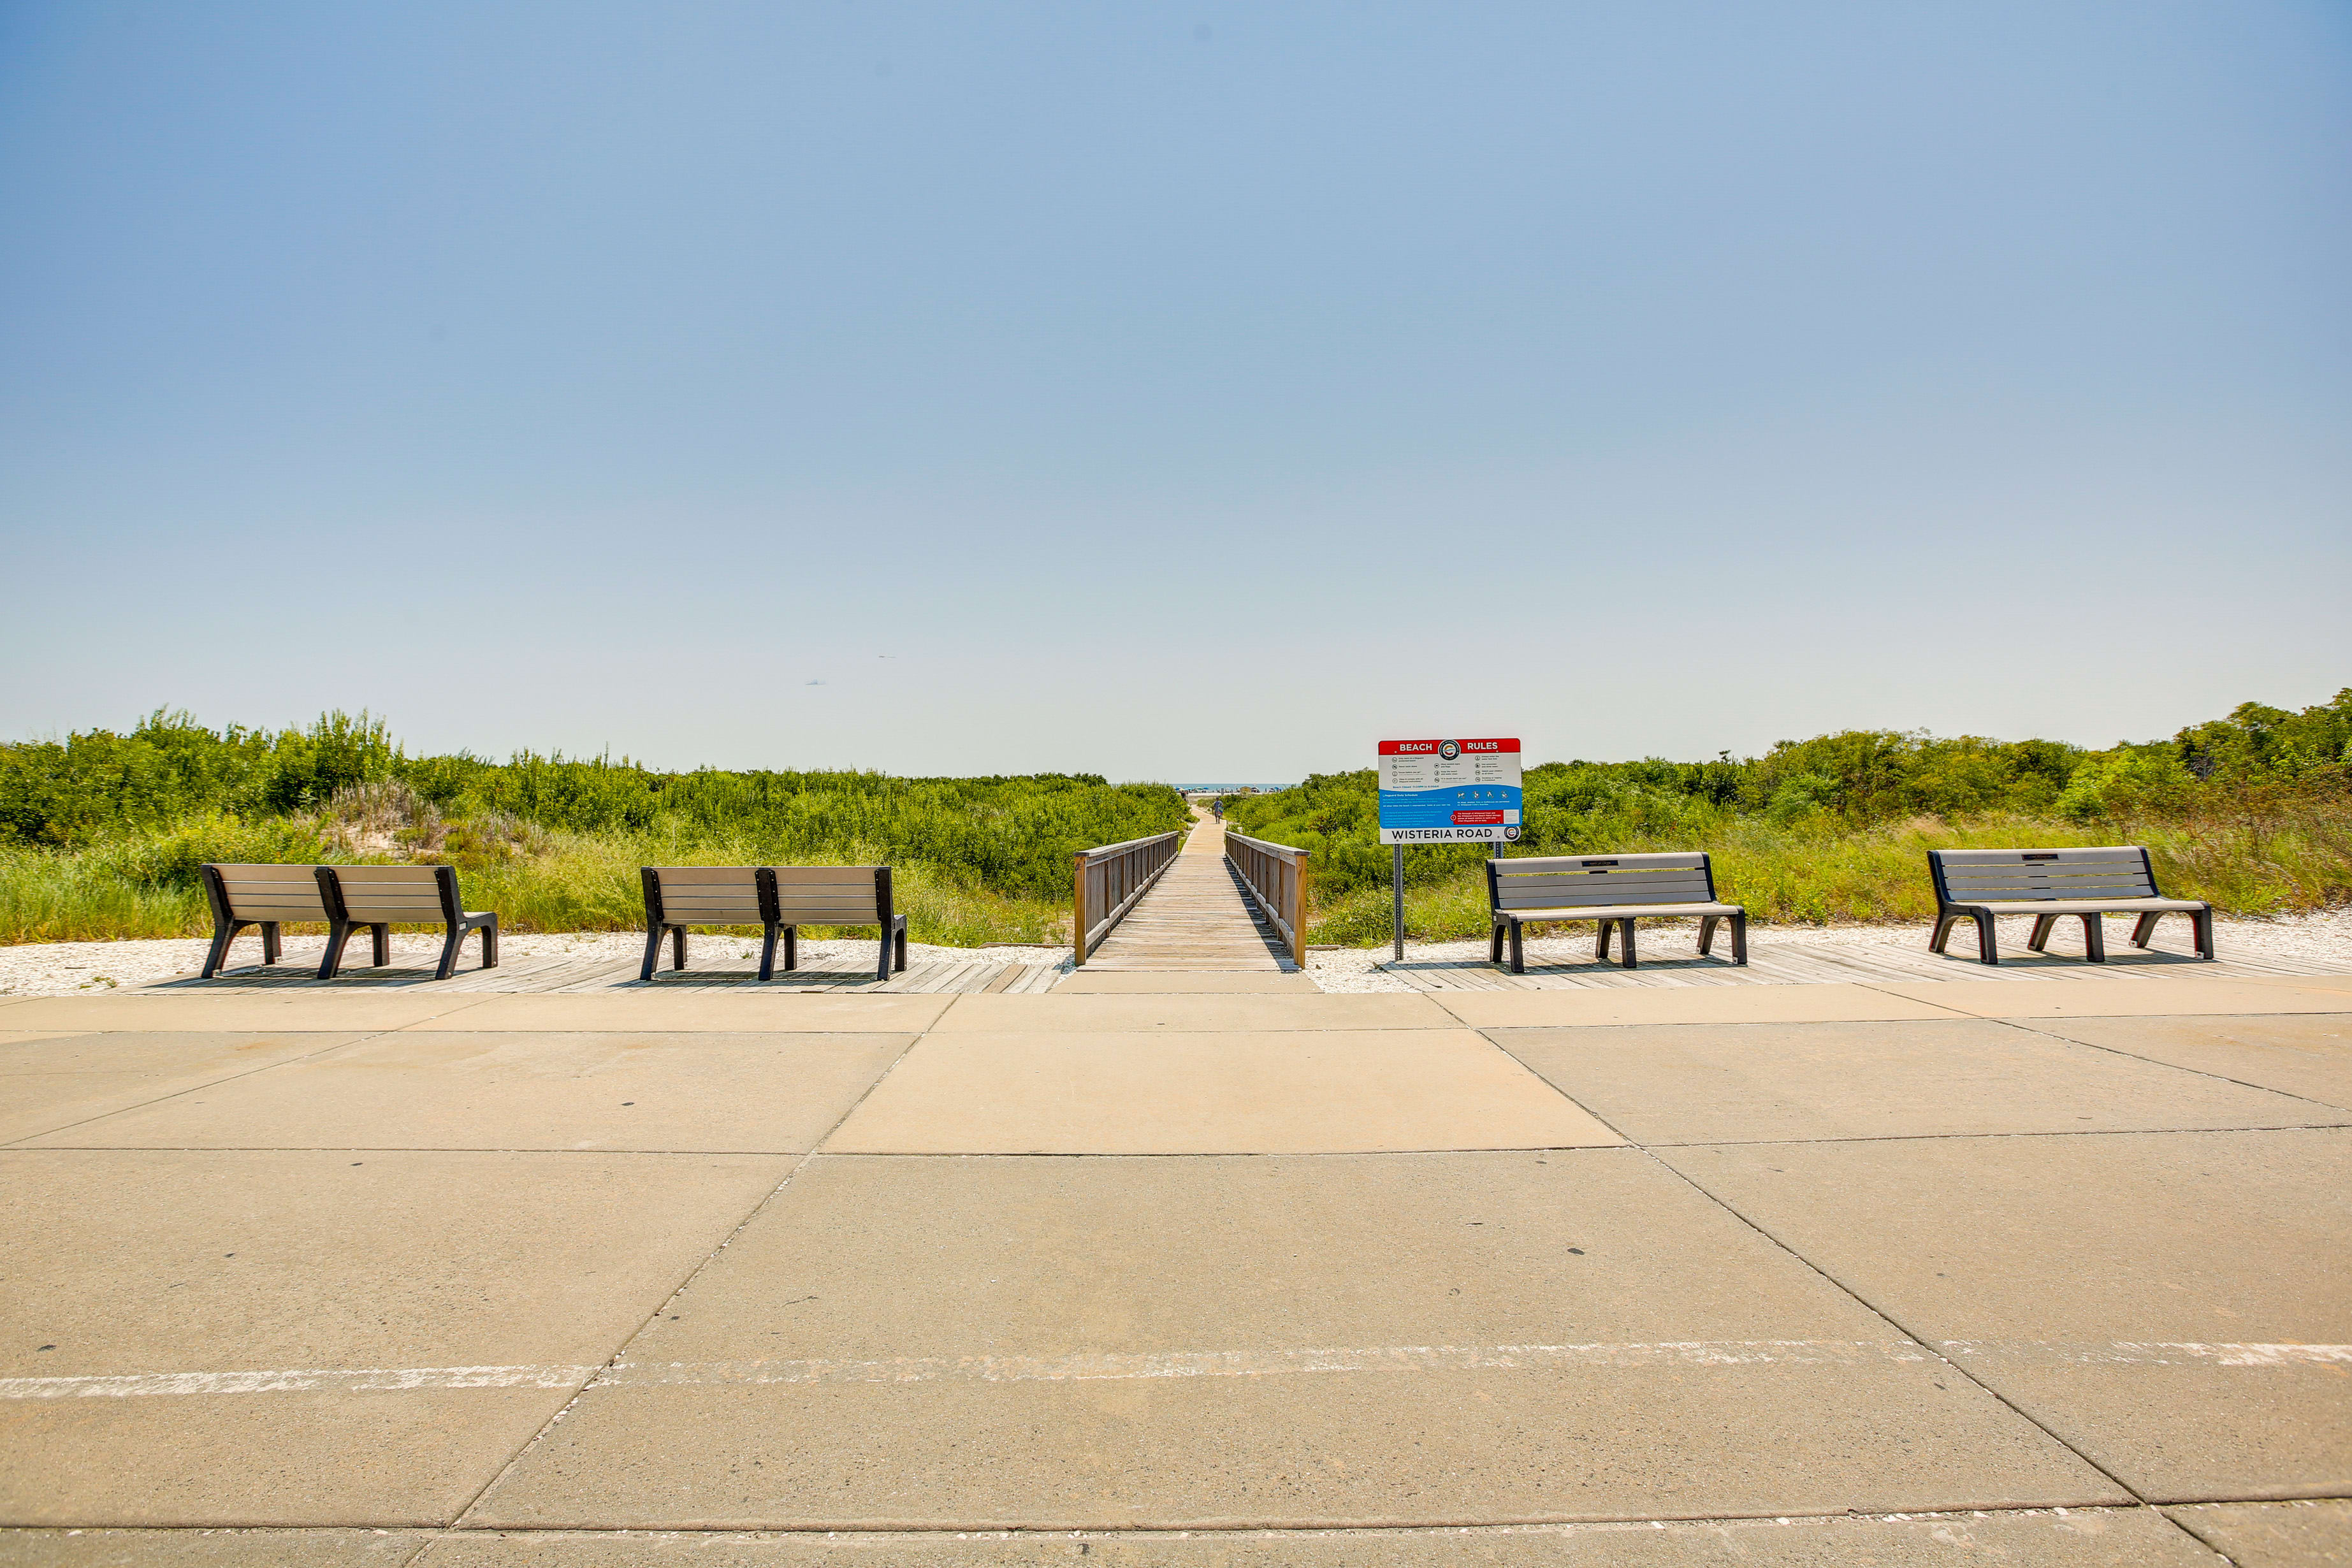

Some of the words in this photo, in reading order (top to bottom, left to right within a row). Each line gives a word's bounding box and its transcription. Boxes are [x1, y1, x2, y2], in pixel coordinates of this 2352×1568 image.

[1400, 743, 1432, 751] BEACH
[1467, 742, 1498, 750] RULES
[1391, 829, 1453, 839] WISTERIA
[1456, 829, 1493, 838] ROAD
